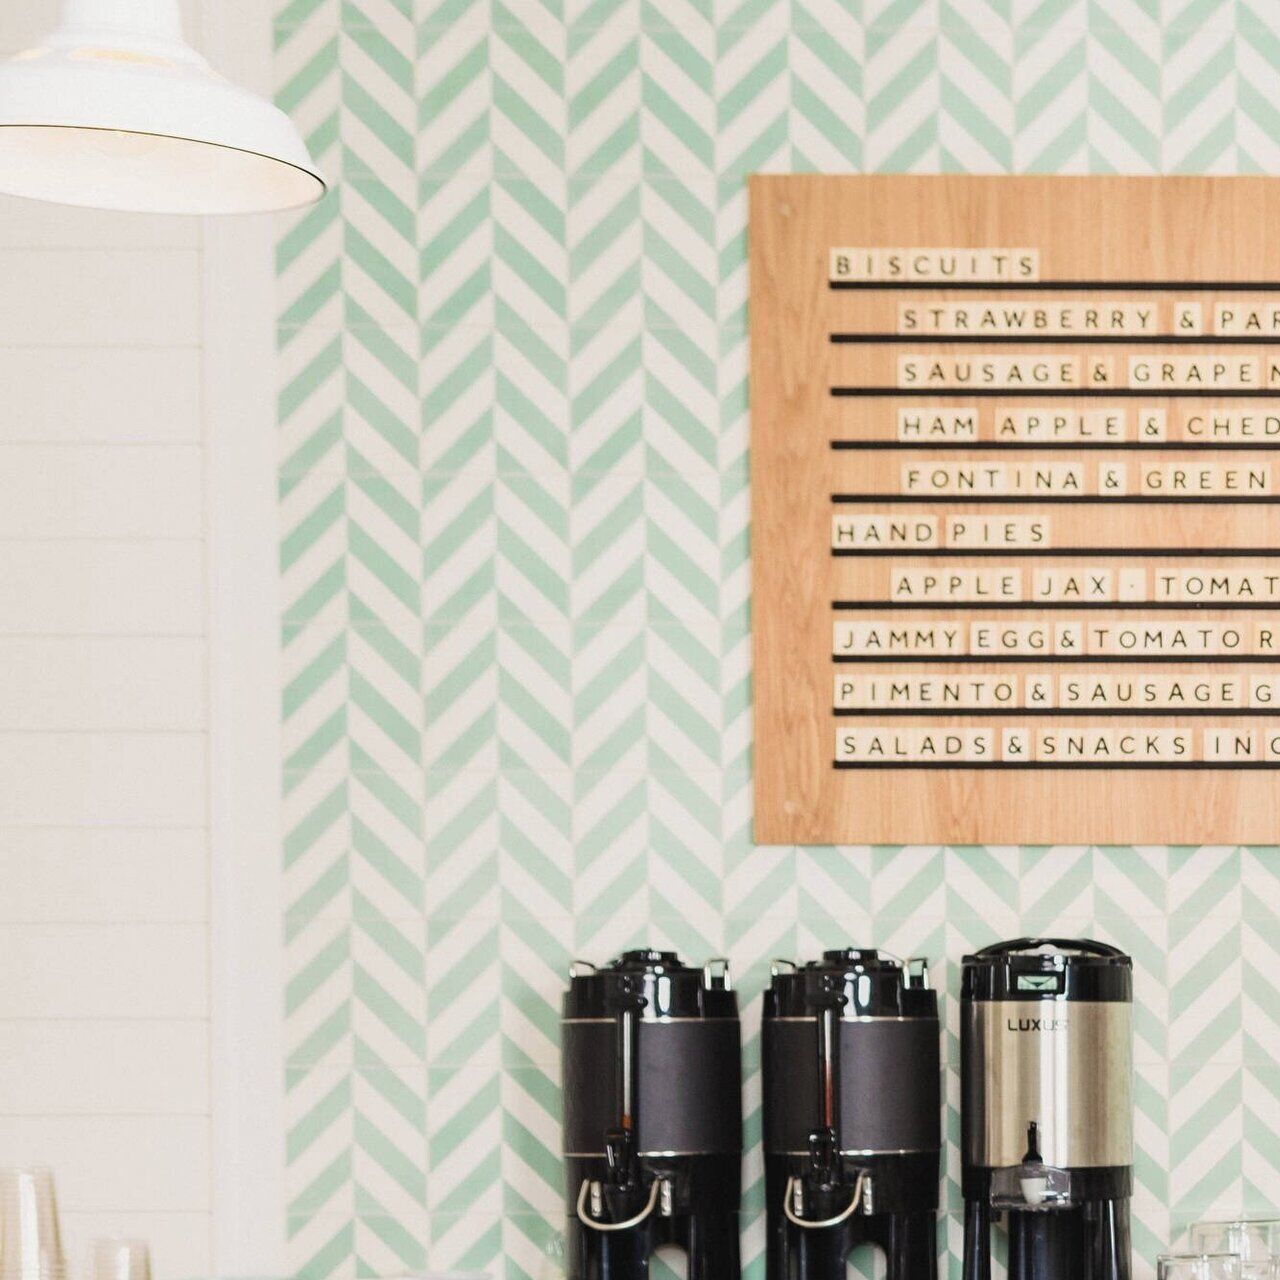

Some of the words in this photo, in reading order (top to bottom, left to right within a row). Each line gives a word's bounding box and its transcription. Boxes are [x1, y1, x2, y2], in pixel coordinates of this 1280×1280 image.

[836, 257, 1034, 276] BISCUITS
[904, 309, 1153, 329] STRAWBERRY
[1179, 312, 1195, 329] &
[904, 363, 1076, 382] SAUSAGE
[1093, 364, 1109, 382] &
[1133, 363, 1255, 383] GRAPE
[904, 417, 974, 435] HAM
[1001, 417, 1120, 436] APPLE
[1145, 418, 1160, 436] &
[908, 470, 1078, 489] FONTINA
[1105, 471, 1119, 489] &
[1146, 470, 1265, 490] GREEN
[837, 523, 933, 542] HAND
[953, 523, 1043, 542] PIES
[897, 576, 1014, 595] APPLE
[1041, 576, 1105, 596] JAX
[842, 630, 958, 649] JAMMY
[977, 629, 1045, 649] EGG
[1060, 630, 1076, 649] &
[1094, 629, 1240, 649] TOMATO
[841, 682, 1013, 702] PIMENTO
[1031, 683, 1045, 702] &
[1067, 682, 1234, 702] SAUSAGE
[844, 735, 986, 756] SALADS
[1008, 736, 1022, 754] &
[1042, 735, 1185, 755] SNACKS
[1215, 736, 1251, 755] IN
